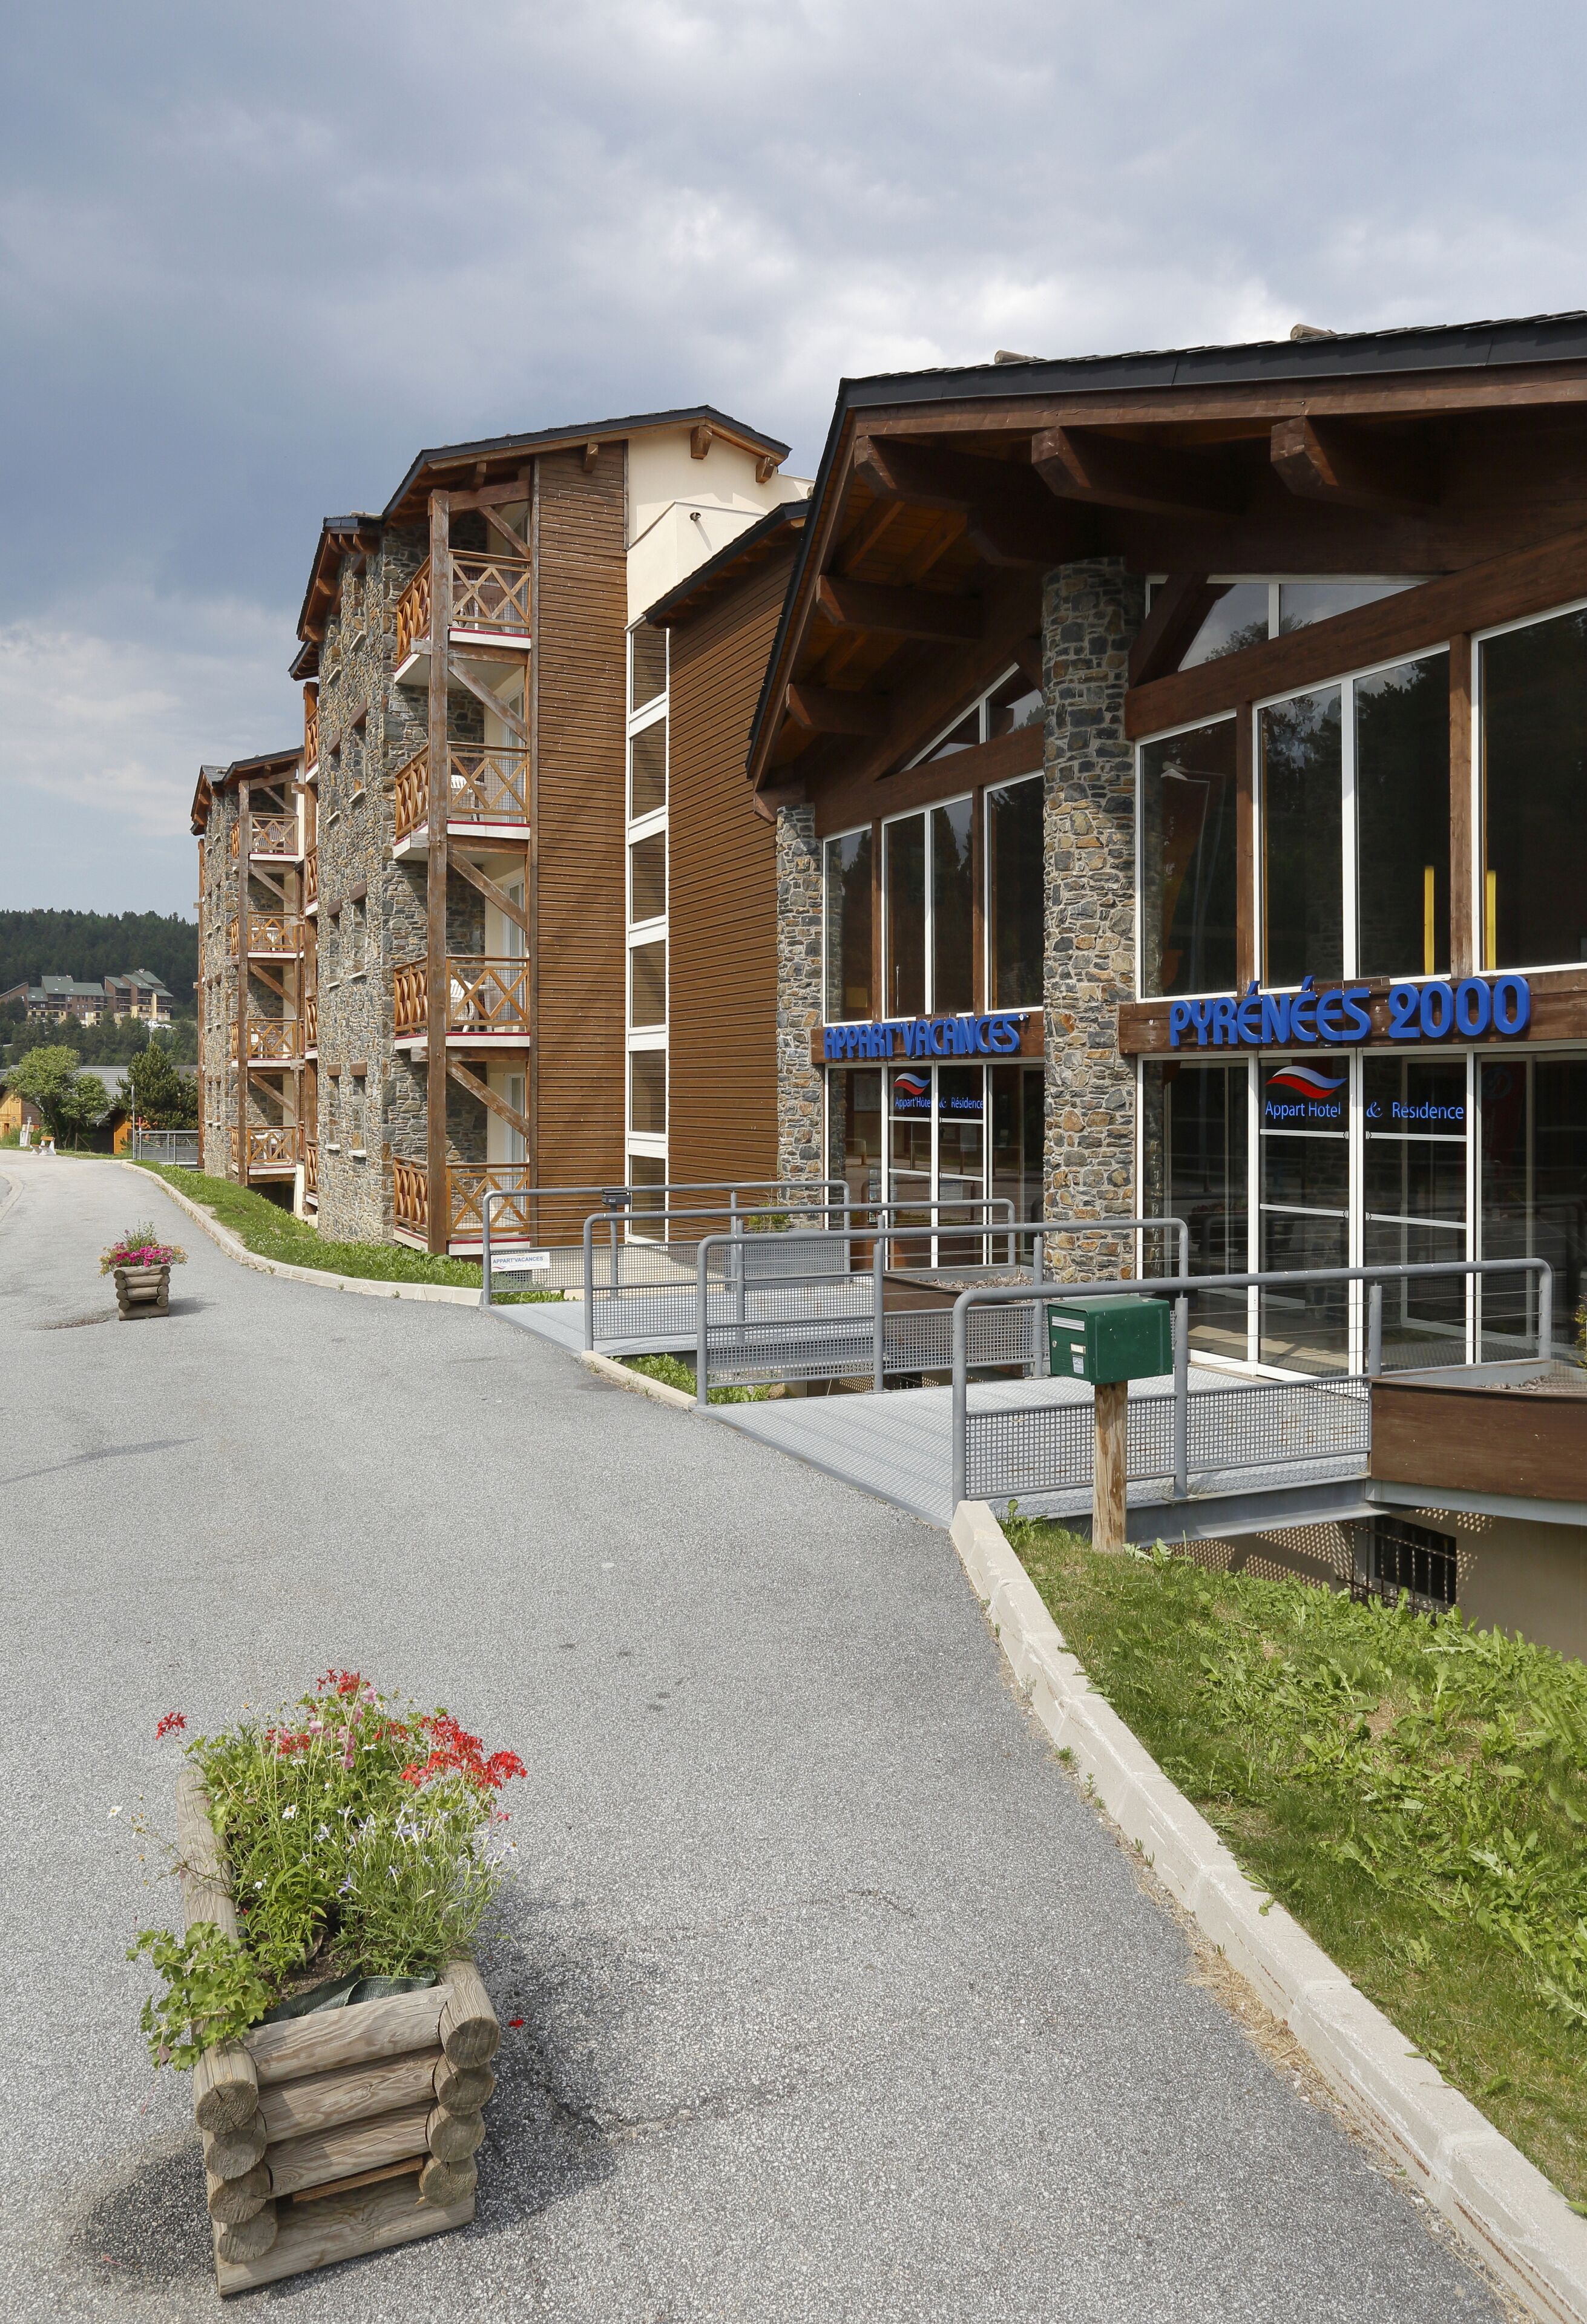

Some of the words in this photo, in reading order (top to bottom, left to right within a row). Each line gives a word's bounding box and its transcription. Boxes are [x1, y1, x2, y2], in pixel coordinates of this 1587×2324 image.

[1170, 976, 1371, 1046] PYRÉNÉES
[1388, 975, 1530, 1038] 2000
[951, 1097, 984, 1109] Résidence
[1265, 1100, 1305, 1120] Appart
[1366, 1101, 1383, 1118] &
[1392, 1101, 1464, 1119] Résidence
